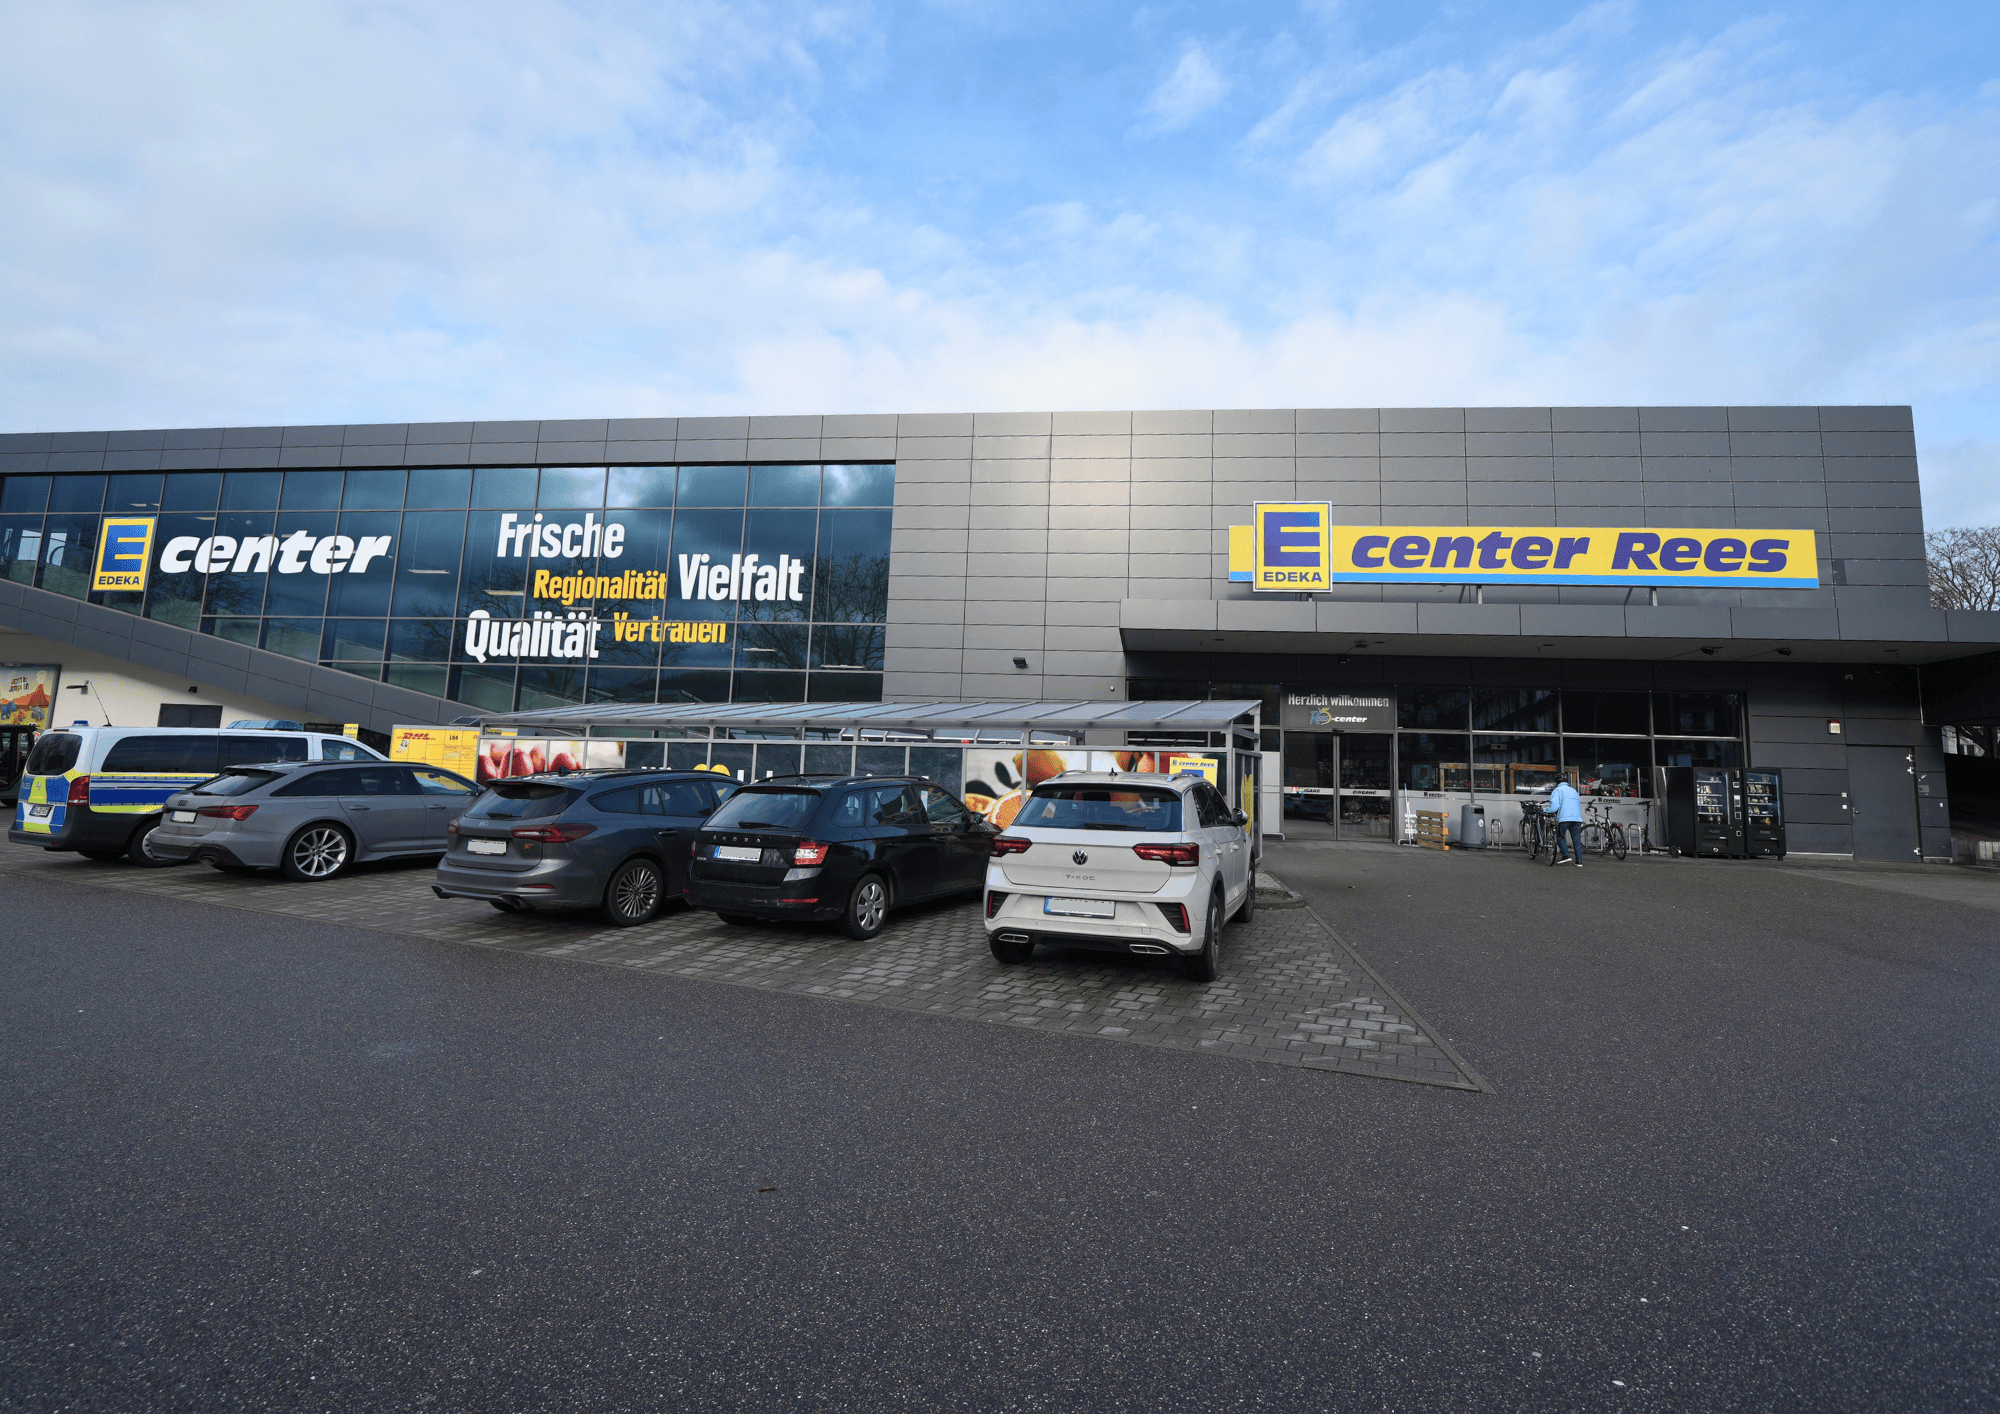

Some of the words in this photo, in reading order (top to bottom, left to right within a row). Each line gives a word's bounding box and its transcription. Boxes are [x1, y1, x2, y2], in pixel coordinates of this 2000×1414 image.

[159, 530, 392, 574] center
[496, 512, 626, 558] Frische
[1263, 512, 1320, 567] E
[1351, 531, 1591, 570] center
[1611, 532, 1790, 573] Rees
[97, 576, 140, 585] EDEKA
[533, 569, 668, 606] Regionalität
[678, 553, 805, 602] Vielfalt
[1263, 571, 1323, 583] EDEKA
[465, 609, 602, 664] Qualität
[613, 611, 727, 643] Vertrauen
[1288, 693, 1328, 706] Herzlich
[1330, 694, 1389, 707] willkommen
[402, 732, 431, 740] DHL
